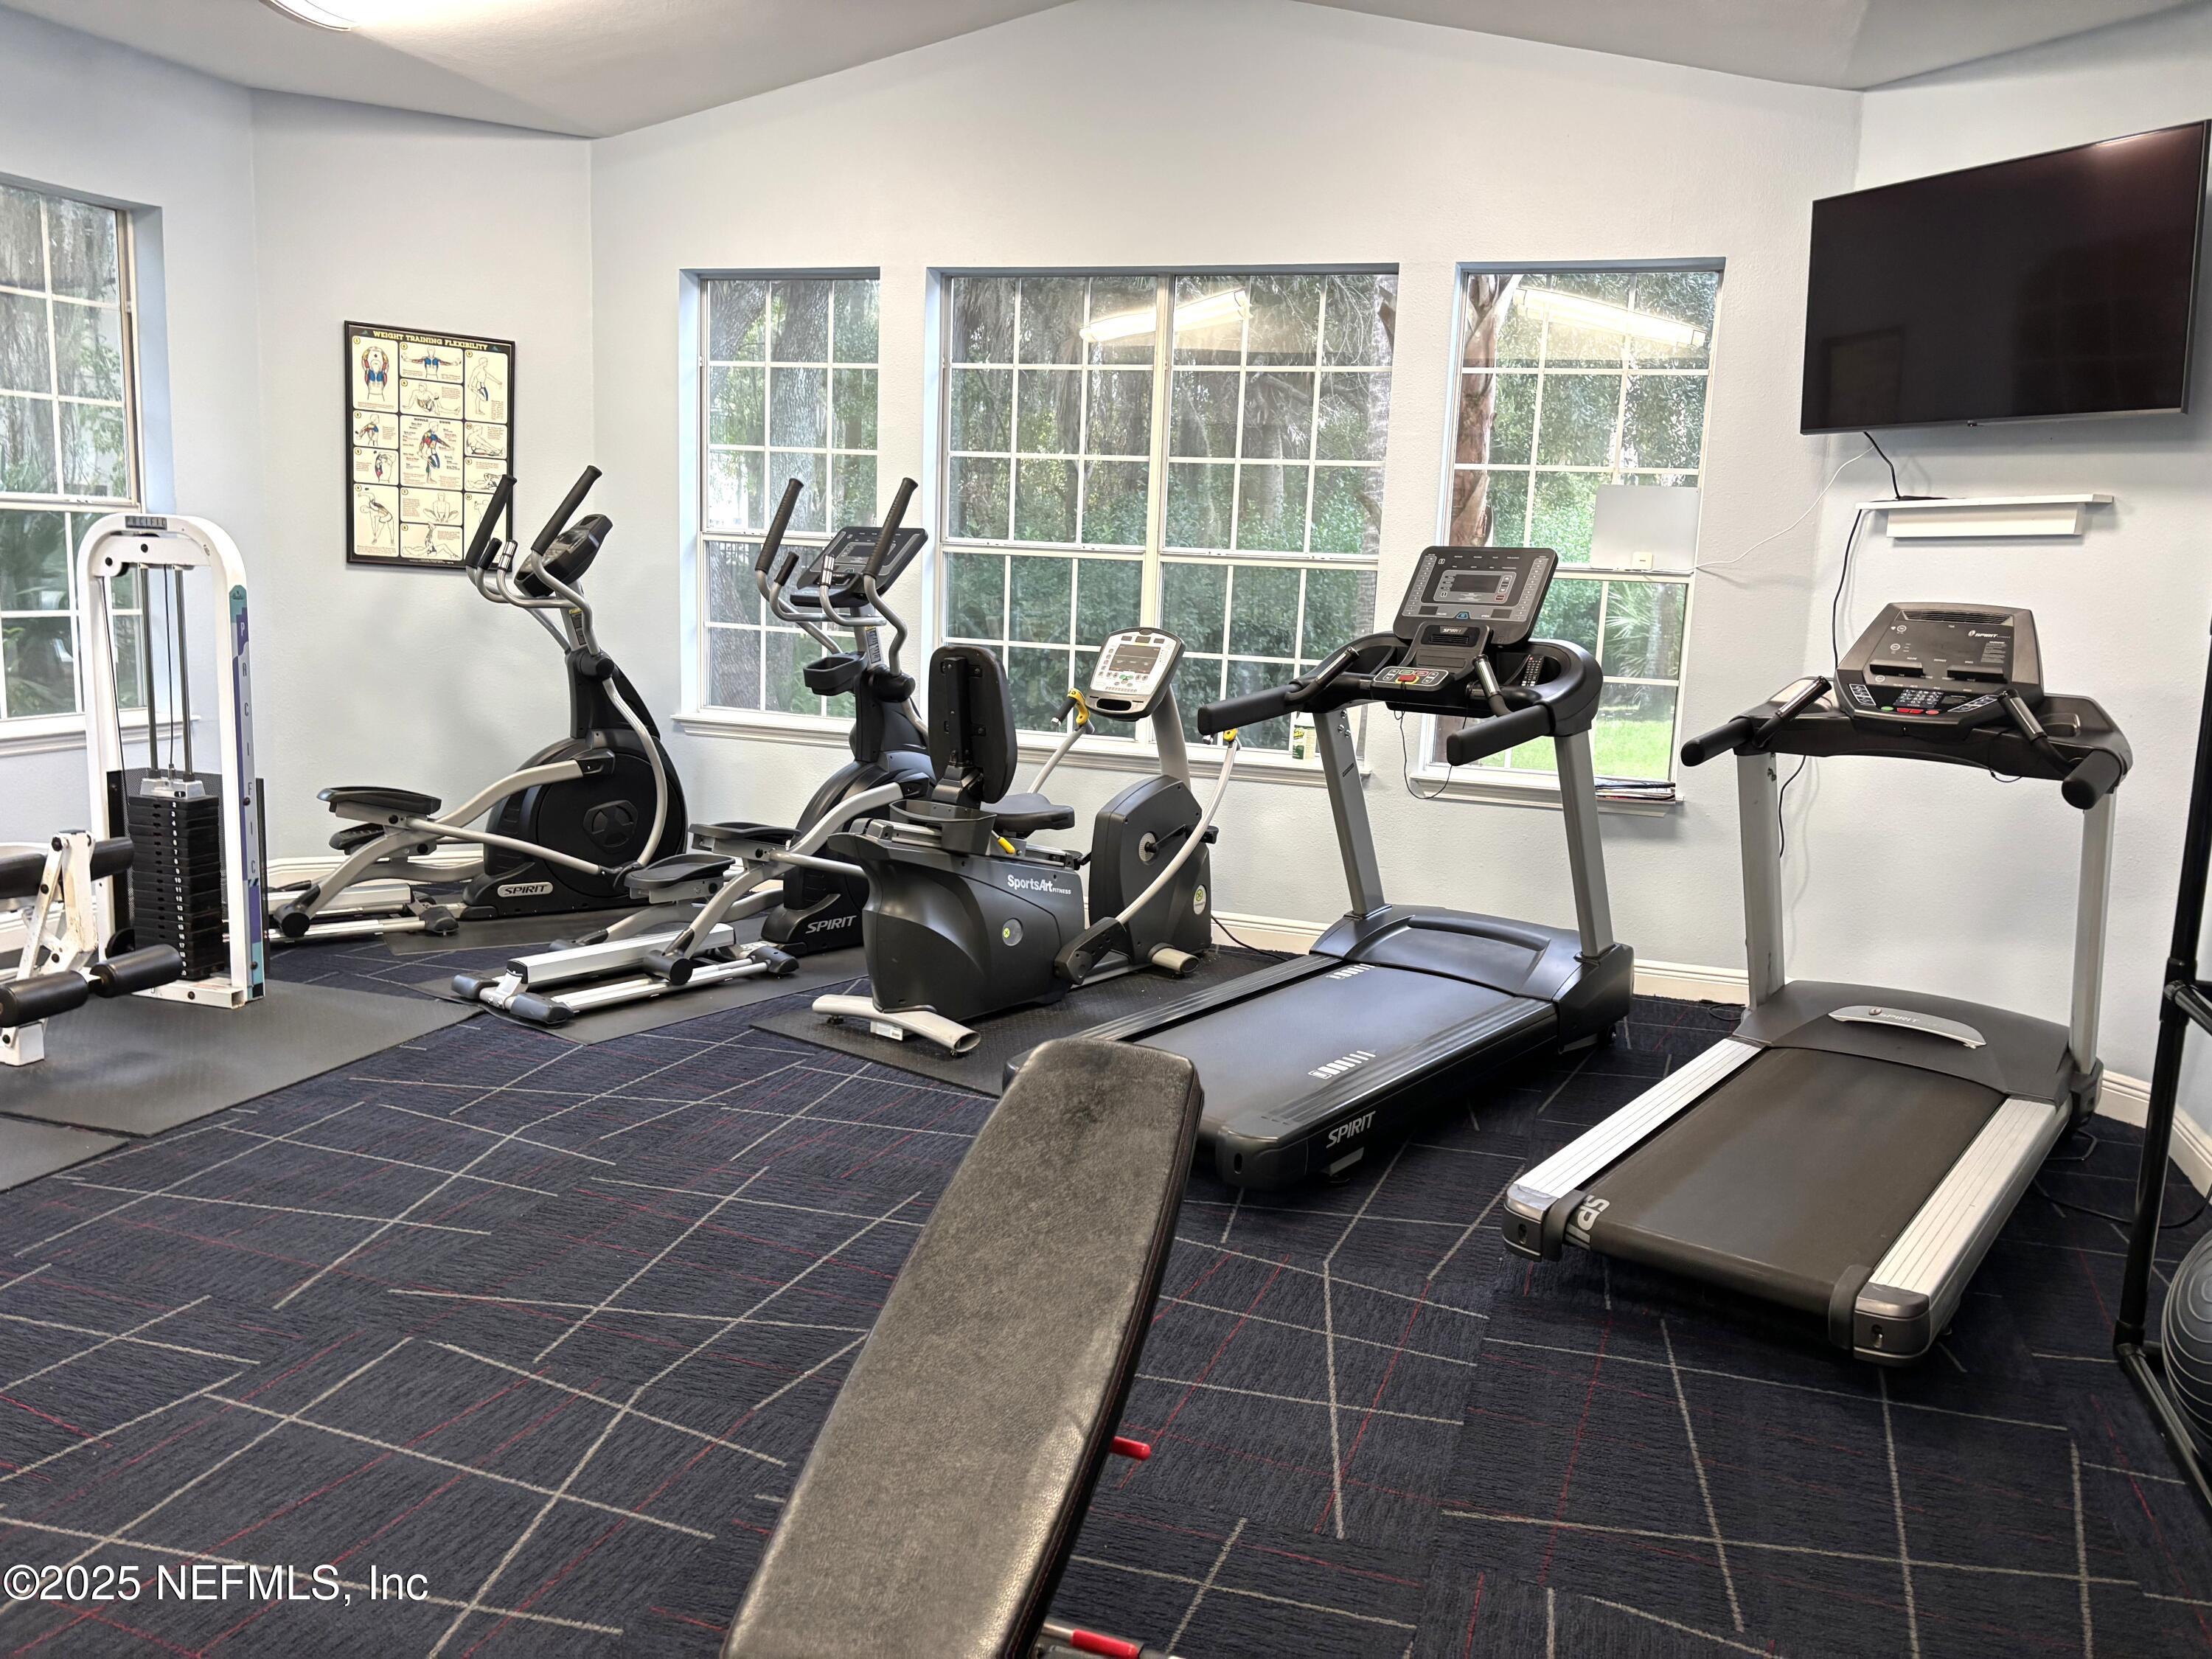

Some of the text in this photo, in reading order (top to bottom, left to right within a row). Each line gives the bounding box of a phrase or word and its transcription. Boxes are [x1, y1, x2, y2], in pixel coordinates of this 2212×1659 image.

[373, 331, 488, 351] WEIGHT TRAINING FLEXIBILITY
[504, 885, 548, 894] SPIRIT
[1007, 874, 1053, 892] SportsArt
[805, 915, 857, 933] SPIRIT
[1326, 1110, 1376, 1149] SPIRIT
